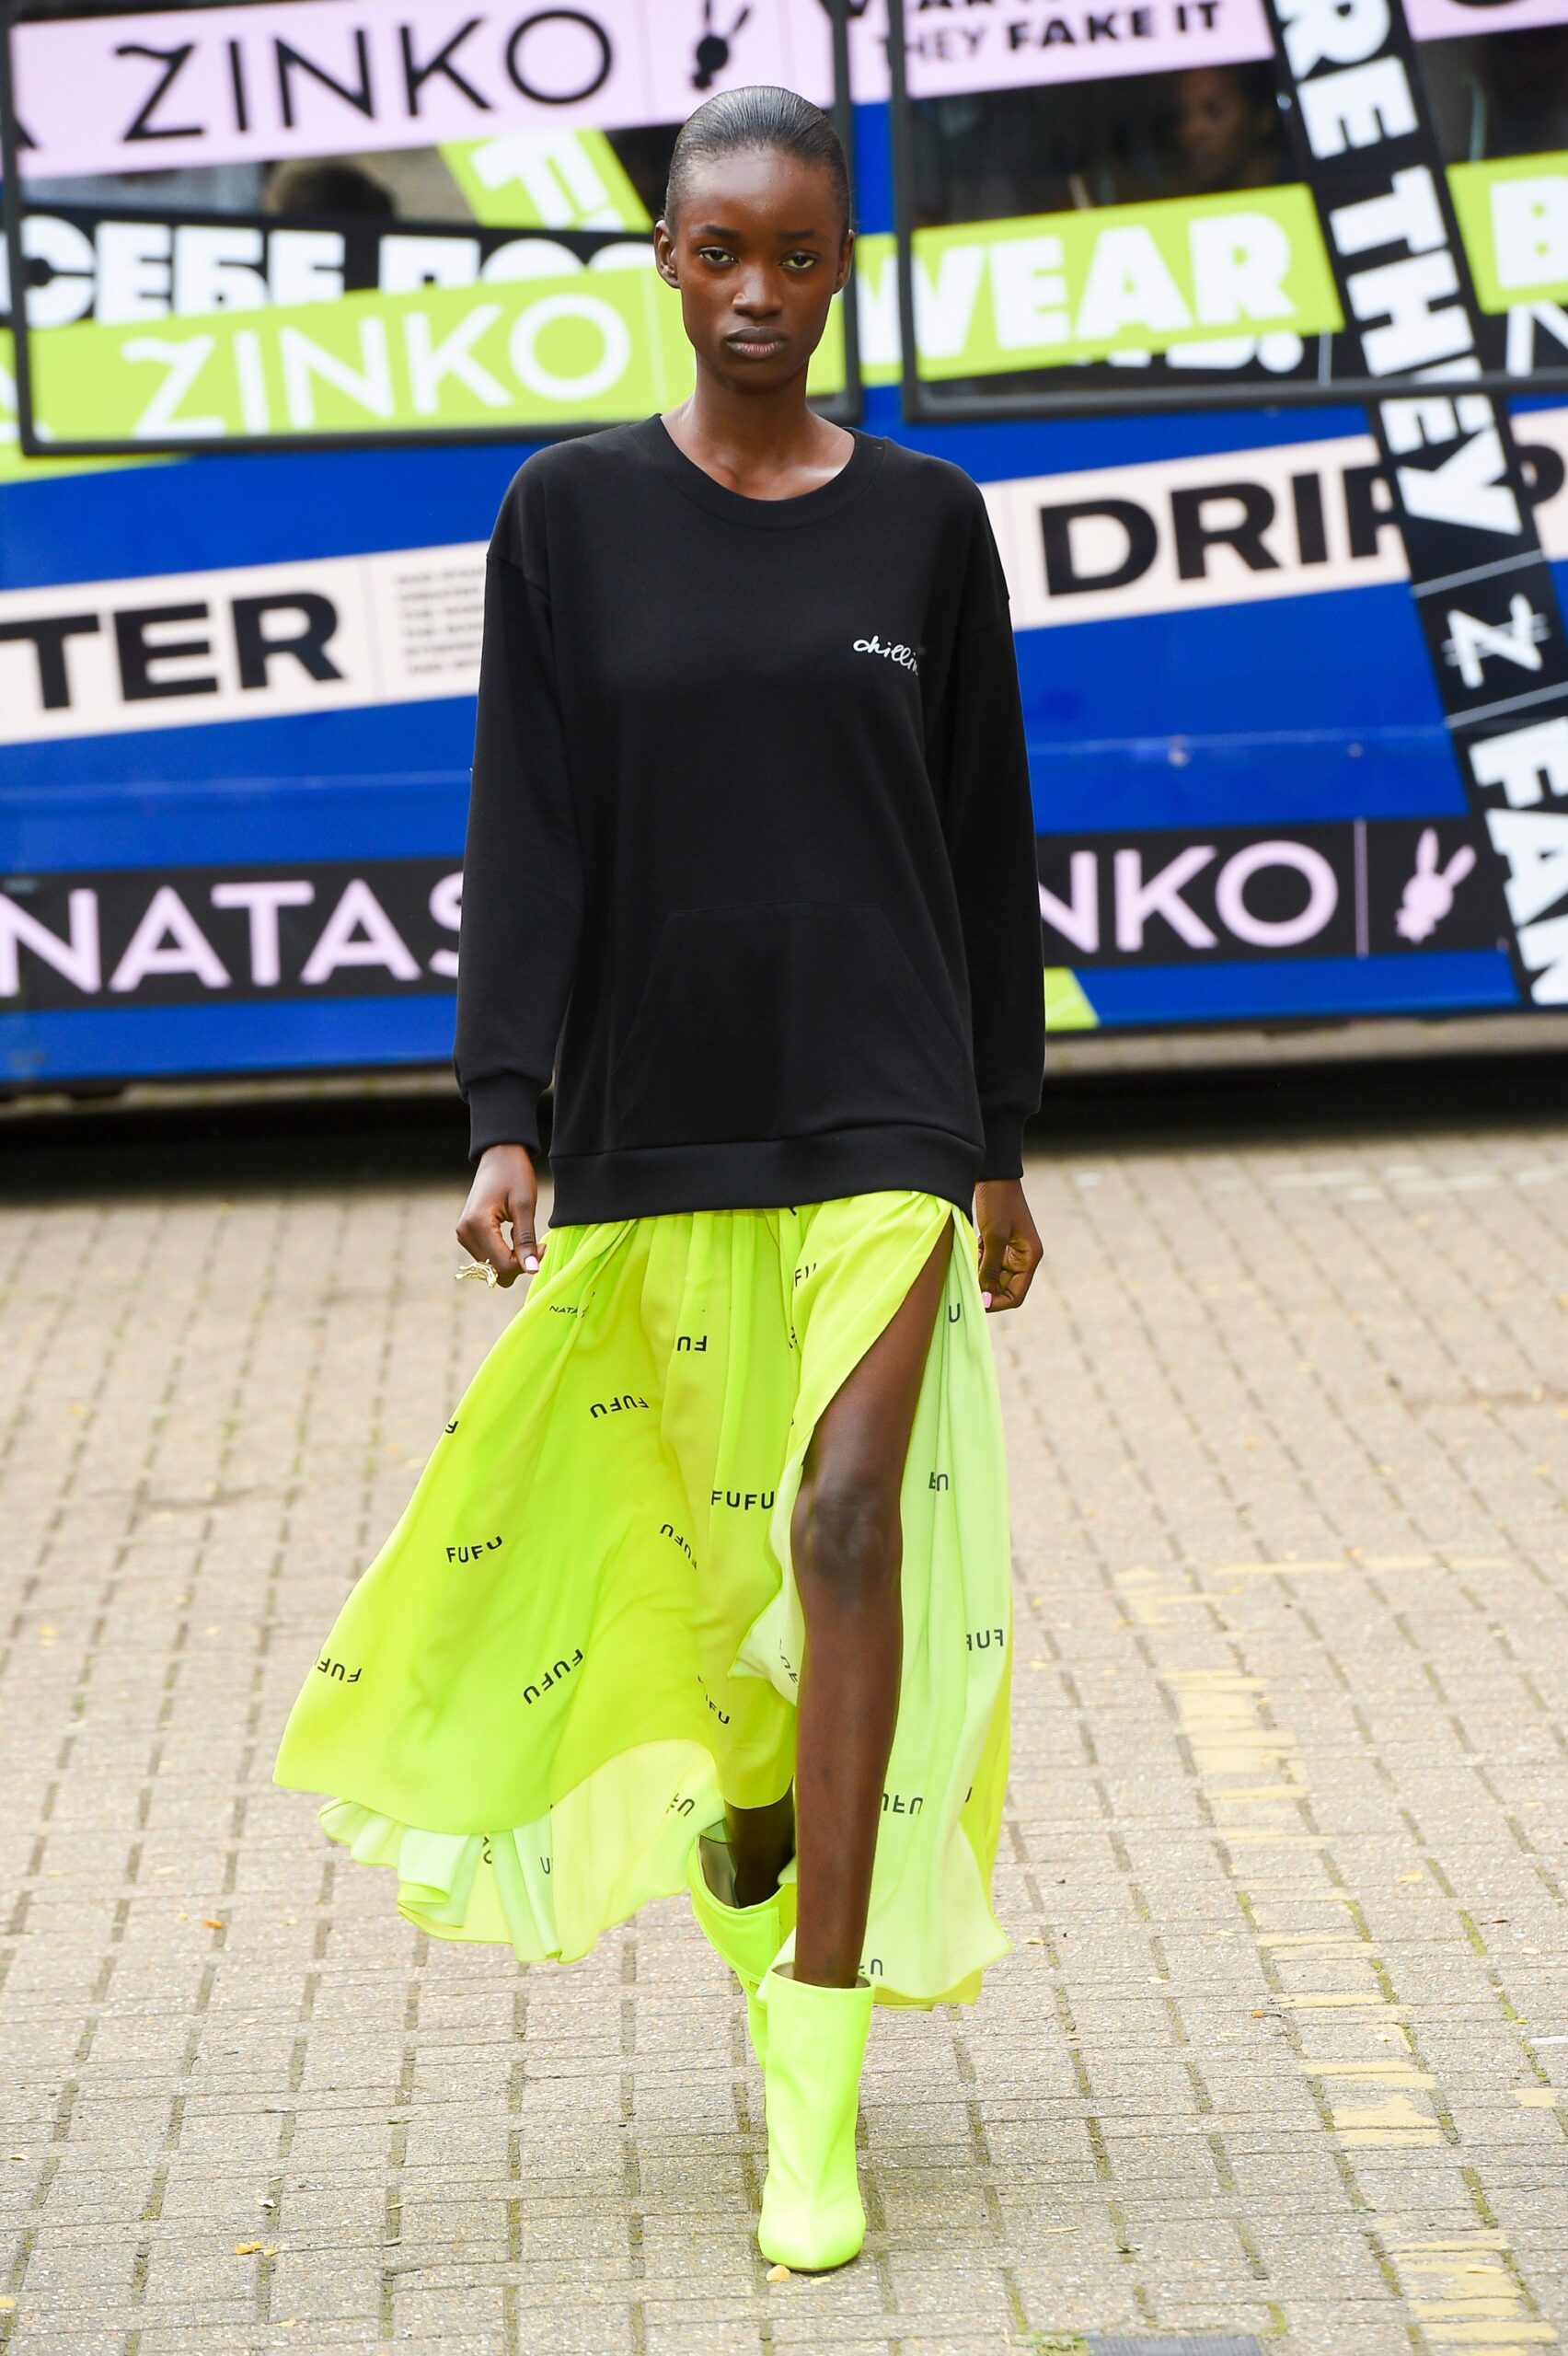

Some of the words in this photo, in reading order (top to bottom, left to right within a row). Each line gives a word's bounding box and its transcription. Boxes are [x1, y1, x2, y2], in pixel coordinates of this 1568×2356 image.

[115, 9, 613, 142] ZINKO
[877, 25, 985, 61] HEY
[1009, 8, 1154, 50] FAKE
[1177, 1, 1219, 31] IT
[836, 213, 1296, 366] WEAR
[121, 293, 631, 440] ZINKO
[1329, 164, 1524, 536] THEY
[0, 592, 344, 710] TER
[590, 1395, 649, 1418] FUFU
[710, 1490, 775, 1510] FUFU
[445, 1535, 503, 1564] FUFU
[523, 1648, 583, 1704] FUFU
